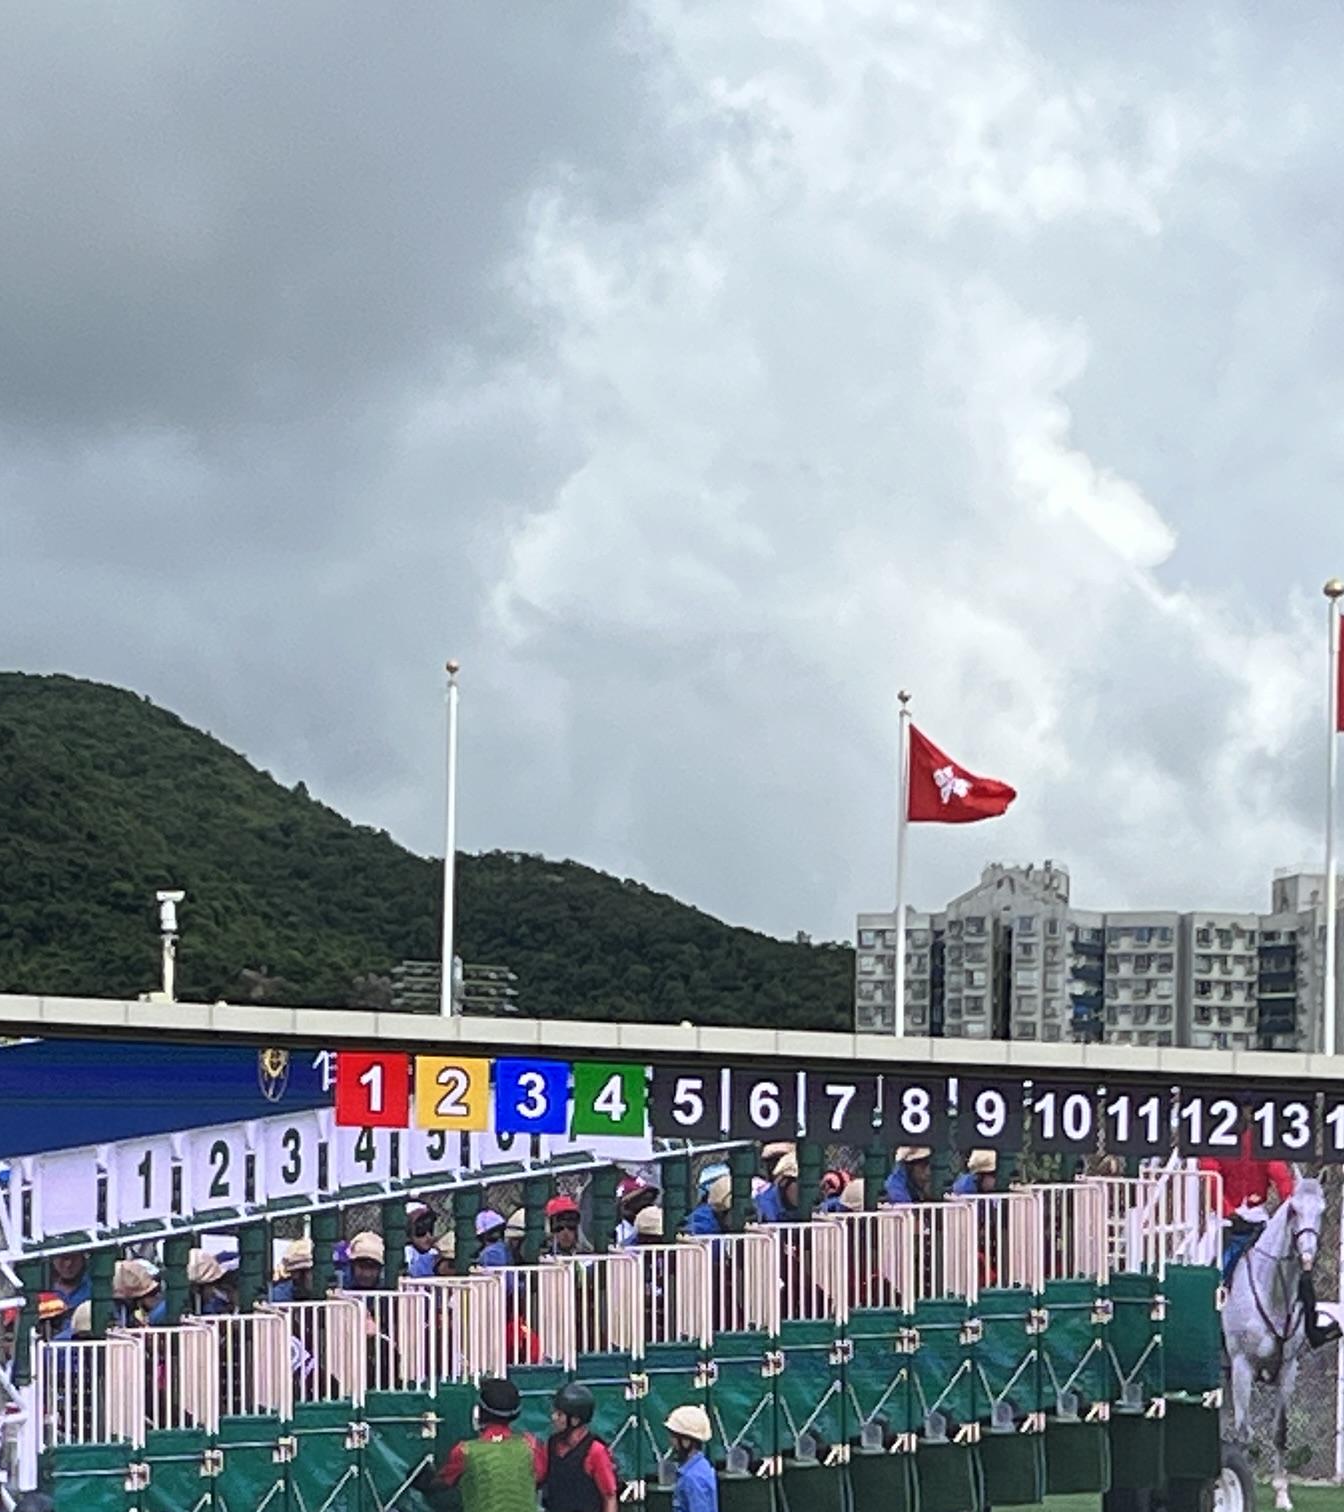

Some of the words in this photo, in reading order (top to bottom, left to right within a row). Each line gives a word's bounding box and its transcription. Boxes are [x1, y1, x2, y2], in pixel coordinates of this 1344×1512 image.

[360, 1066, 381, 1111] 1
[436, 1067, 470, 1116] 2
[517, 1072, 546, 1118] 3
[594, 1075, 626, 1121] 4
[673, 1079, 703, 1125] 5
[750, 1082, 779, 1127] 6
[826, 1085, 855, 1130] 7
[902, 1088, 930, 1133] 8
[976, 1091, 1005, 1136] 9
[1035, 1093, 1091, 1139] 10
[1108, 1096, 1158, 1142] 11
[1181, 1099, 1237, 1145] 12
[1254, 1102, 1310, 1148] 13
[138, 1150, 153, 1210] 1
[209, 1139, 231, 1199] 2
[281, 1127, 302, 1185] 3
